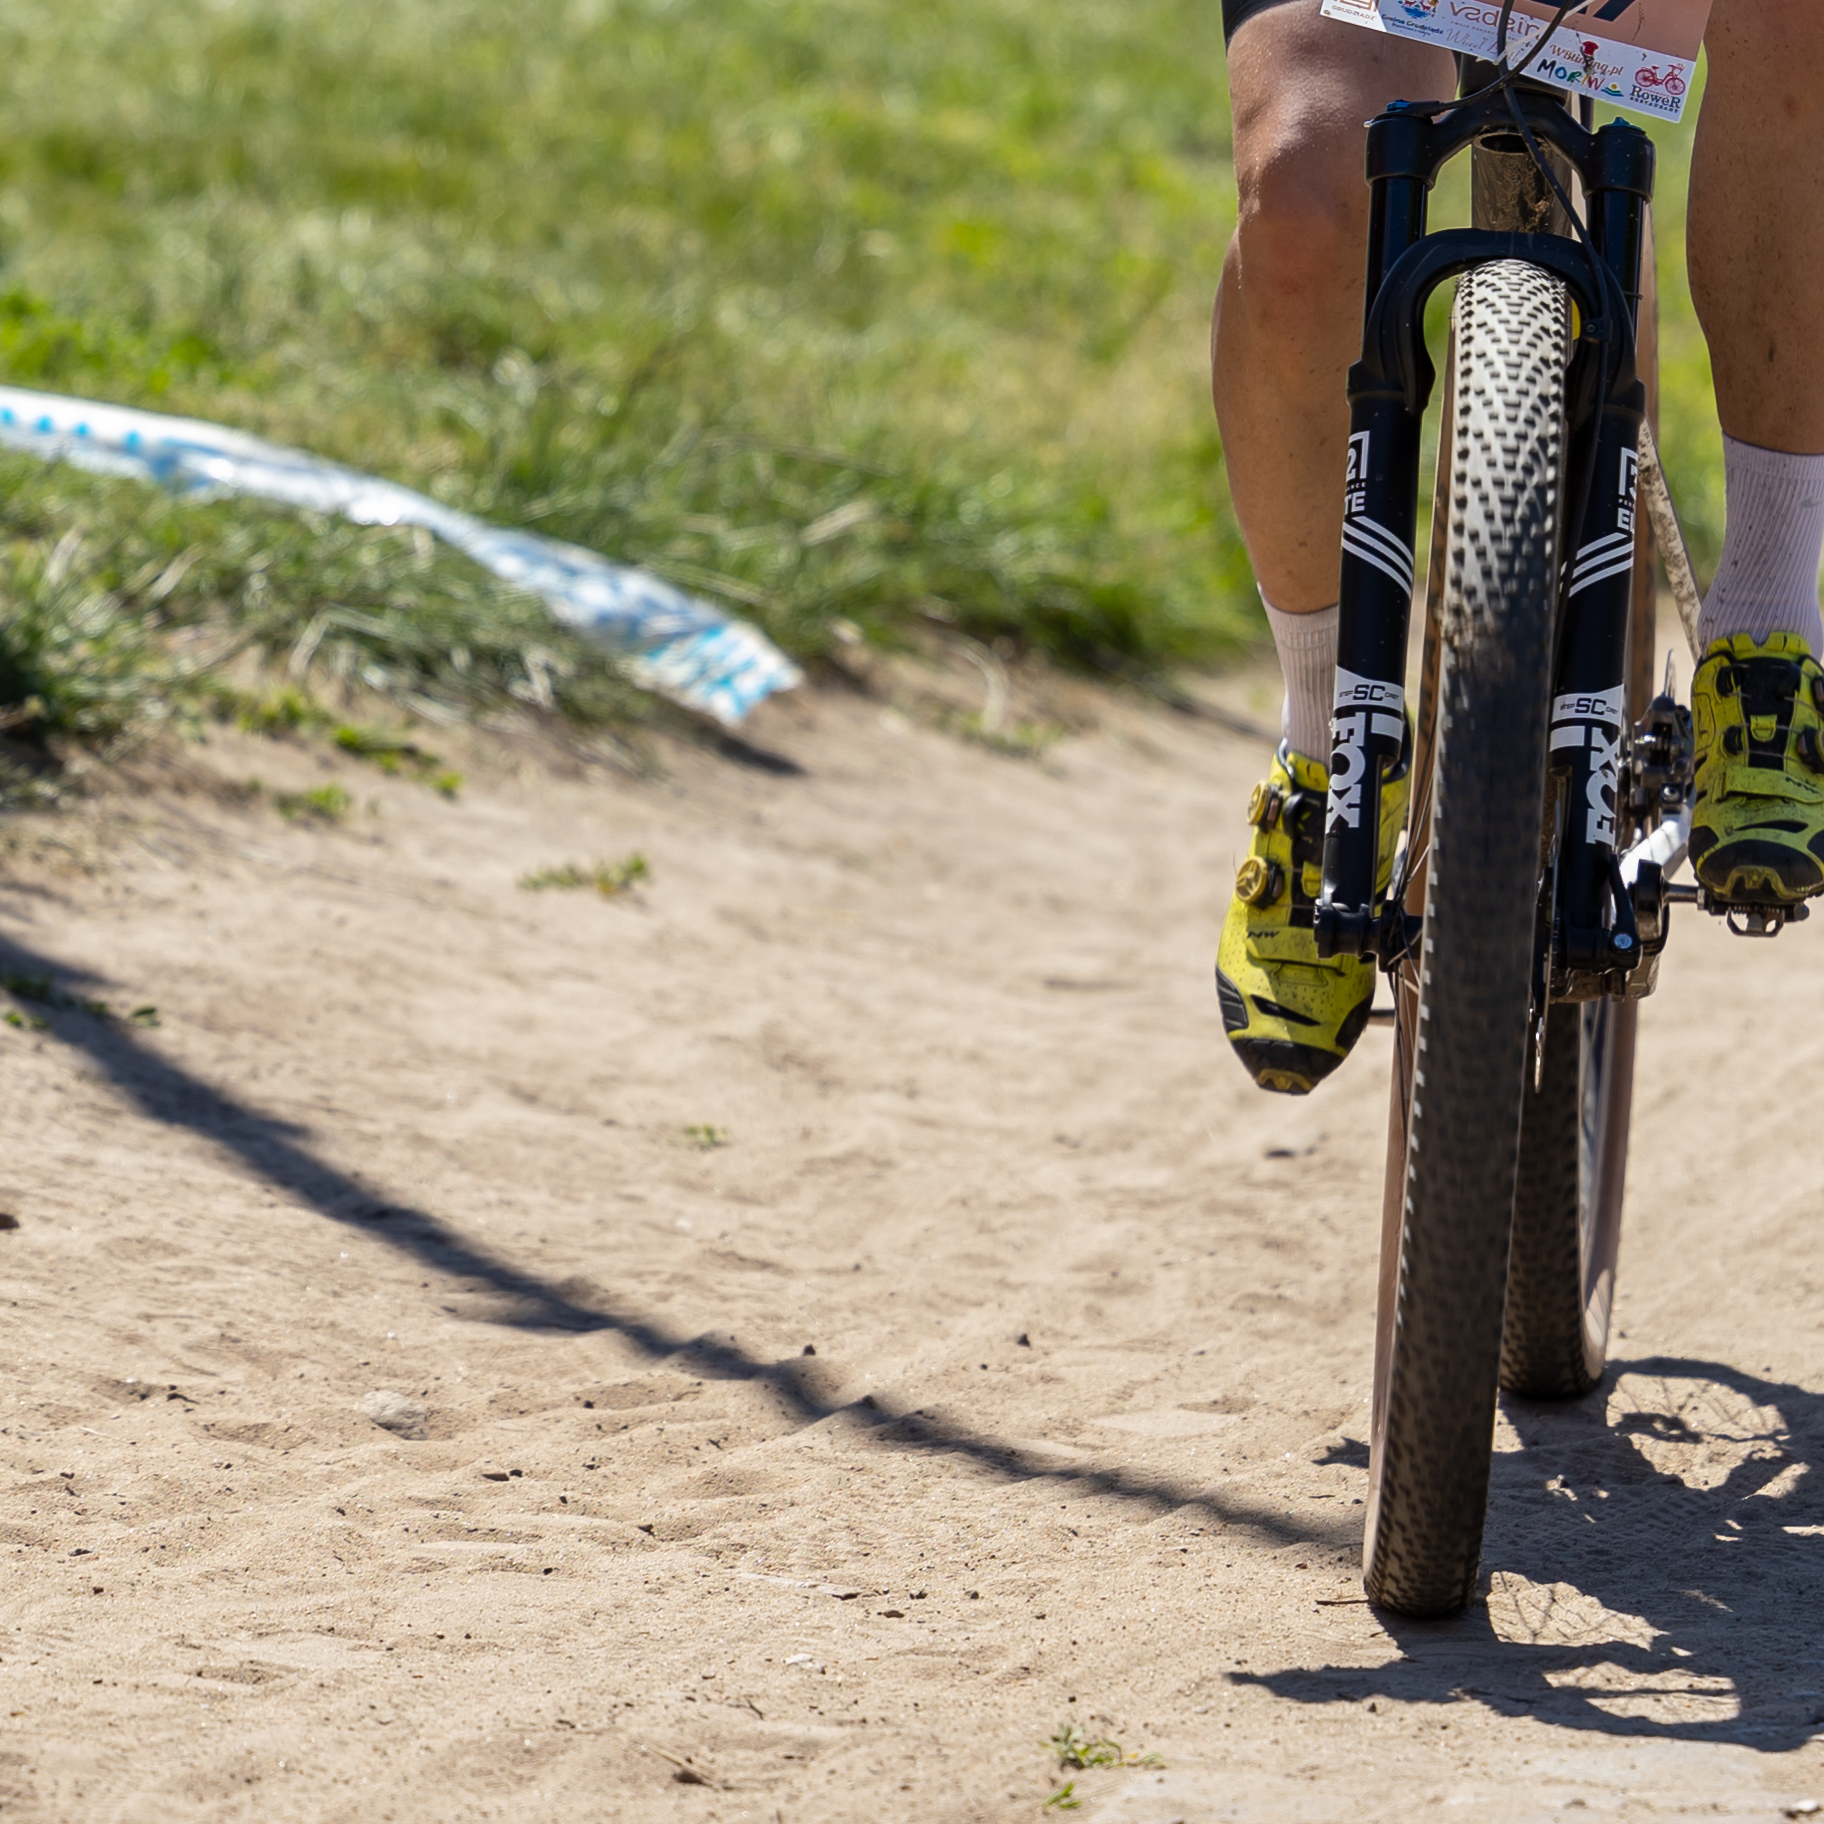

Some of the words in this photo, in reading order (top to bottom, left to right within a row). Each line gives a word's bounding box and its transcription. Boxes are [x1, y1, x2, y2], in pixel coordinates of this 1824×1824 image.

[1537, 58, 1606, 91] MORIW
[1353, 684, 1386, 701] SC
[1575, 697, 1607, 716] SC
[1325, 712, 1366, 834] FOX
[1585, 726, 1621, 852] FOX
